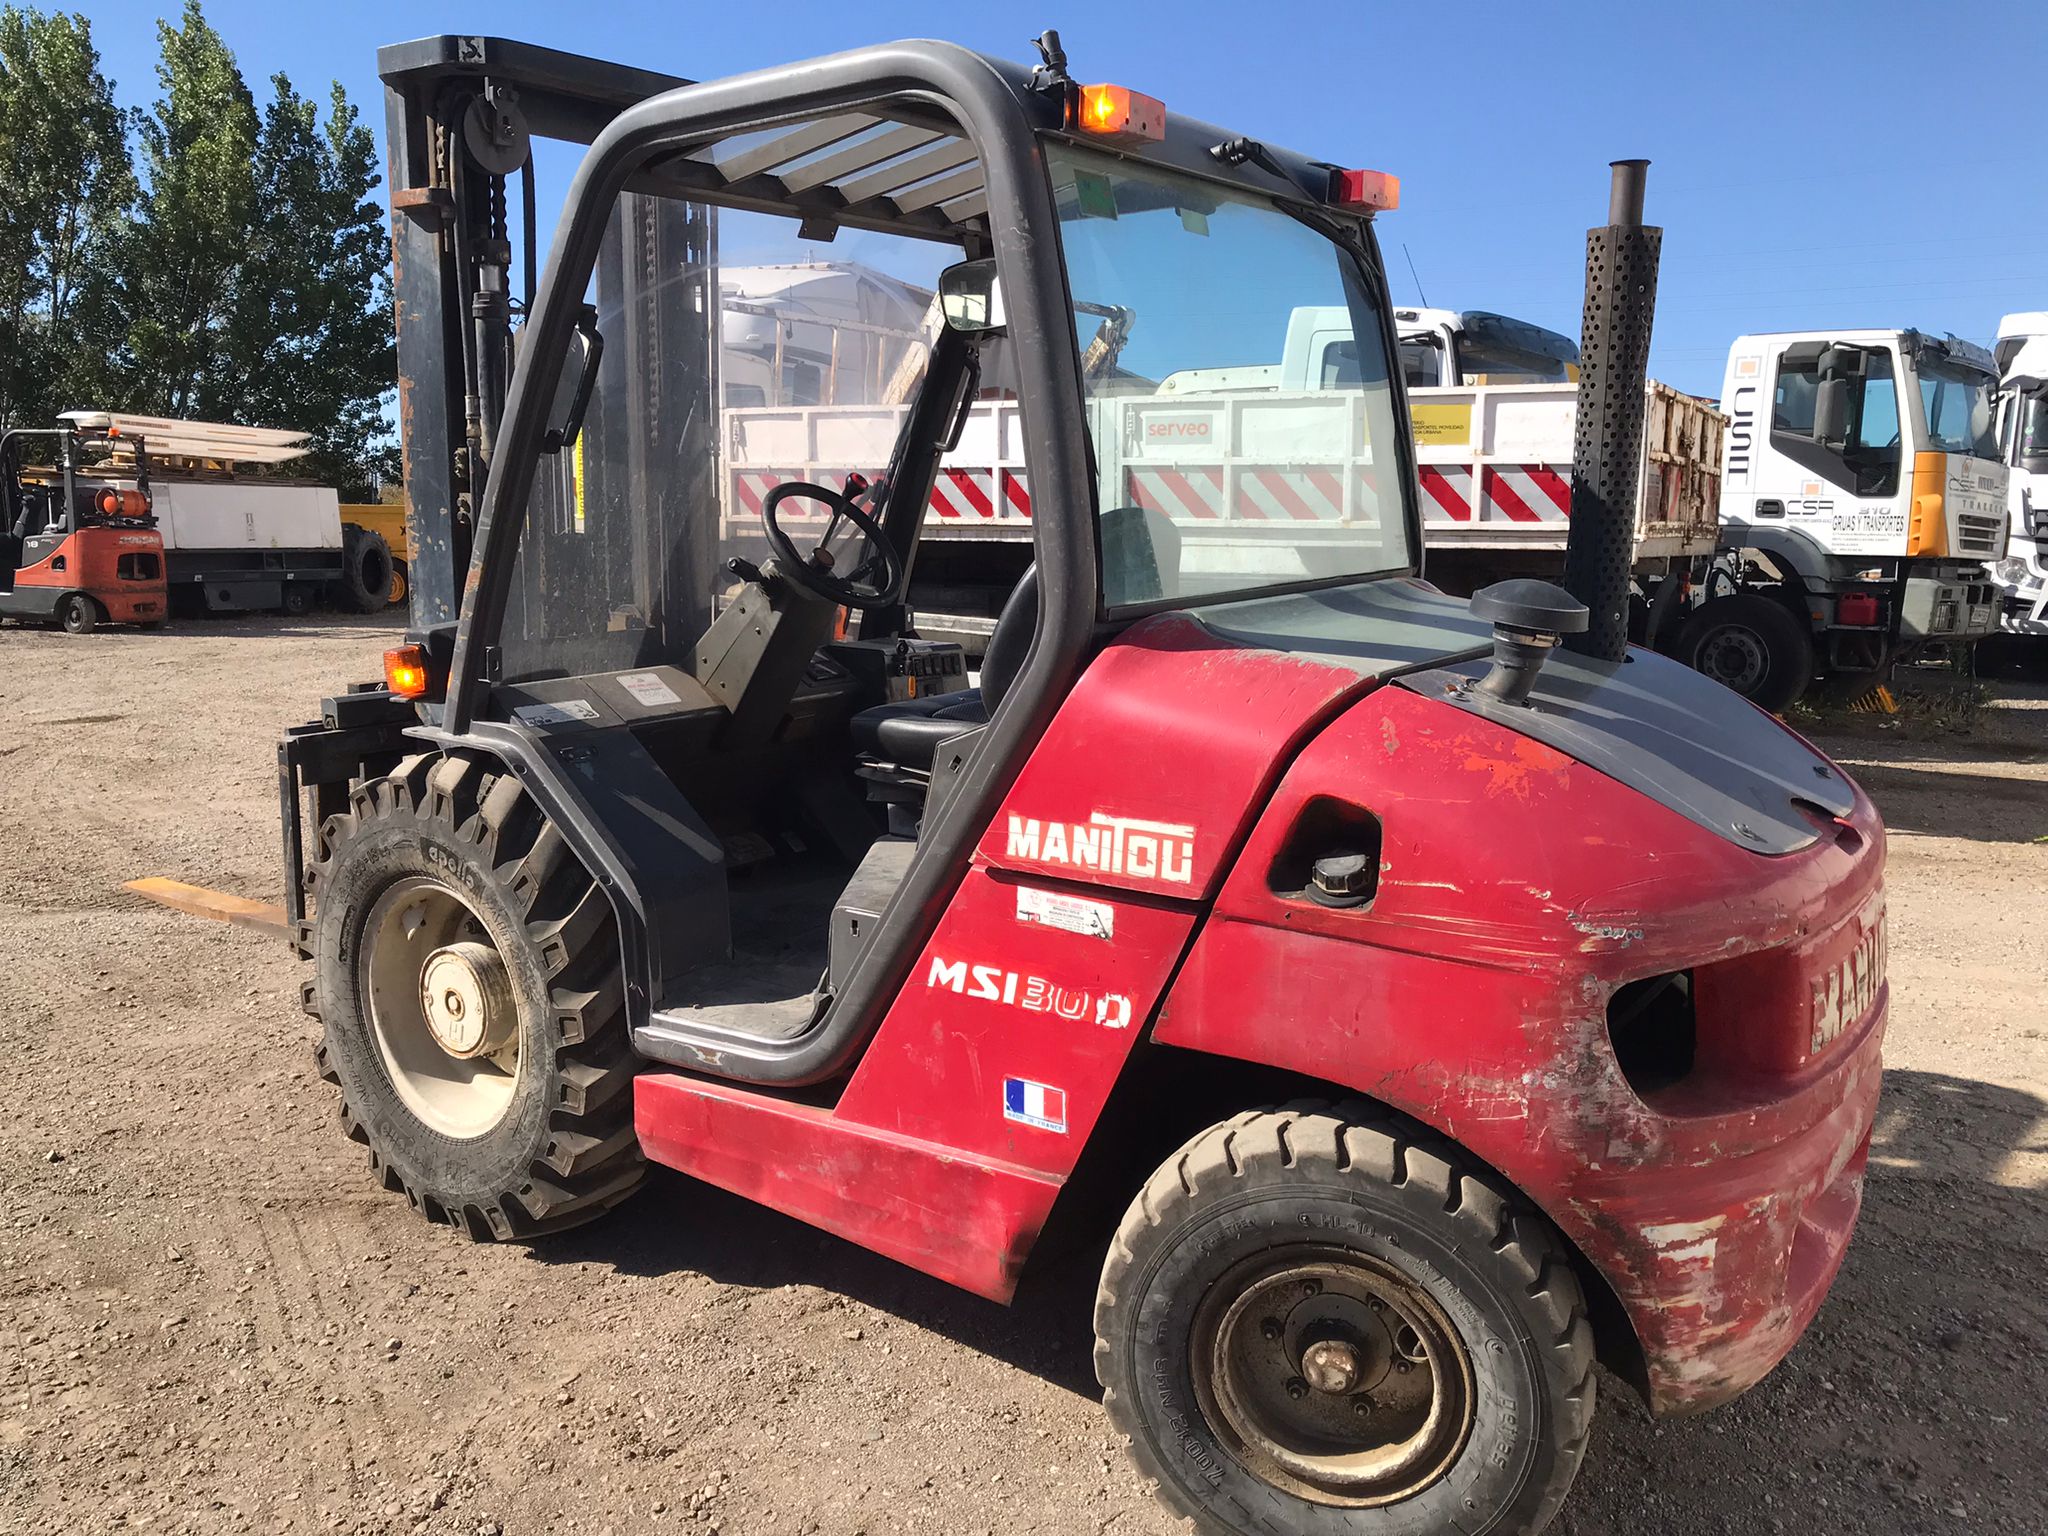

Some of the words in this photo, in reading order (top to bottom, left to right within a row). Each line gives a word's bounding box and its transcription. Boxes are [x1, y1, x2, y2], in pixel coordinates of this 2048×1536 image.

[1148, 423, 1209, 436] serveo
[1787, 500, 1834, 515] CSA
[1832, 515, 1856, 531] GRUAS
[1858, 515, 1862, 531] Y
[1864, 515, 1904, 531] TRANSPORTES
[27, 540, 39, 548] 18
[1006, 812, 1194, 884] MANITOU
[1037, 1120, 1063, 1132] FRANCE
